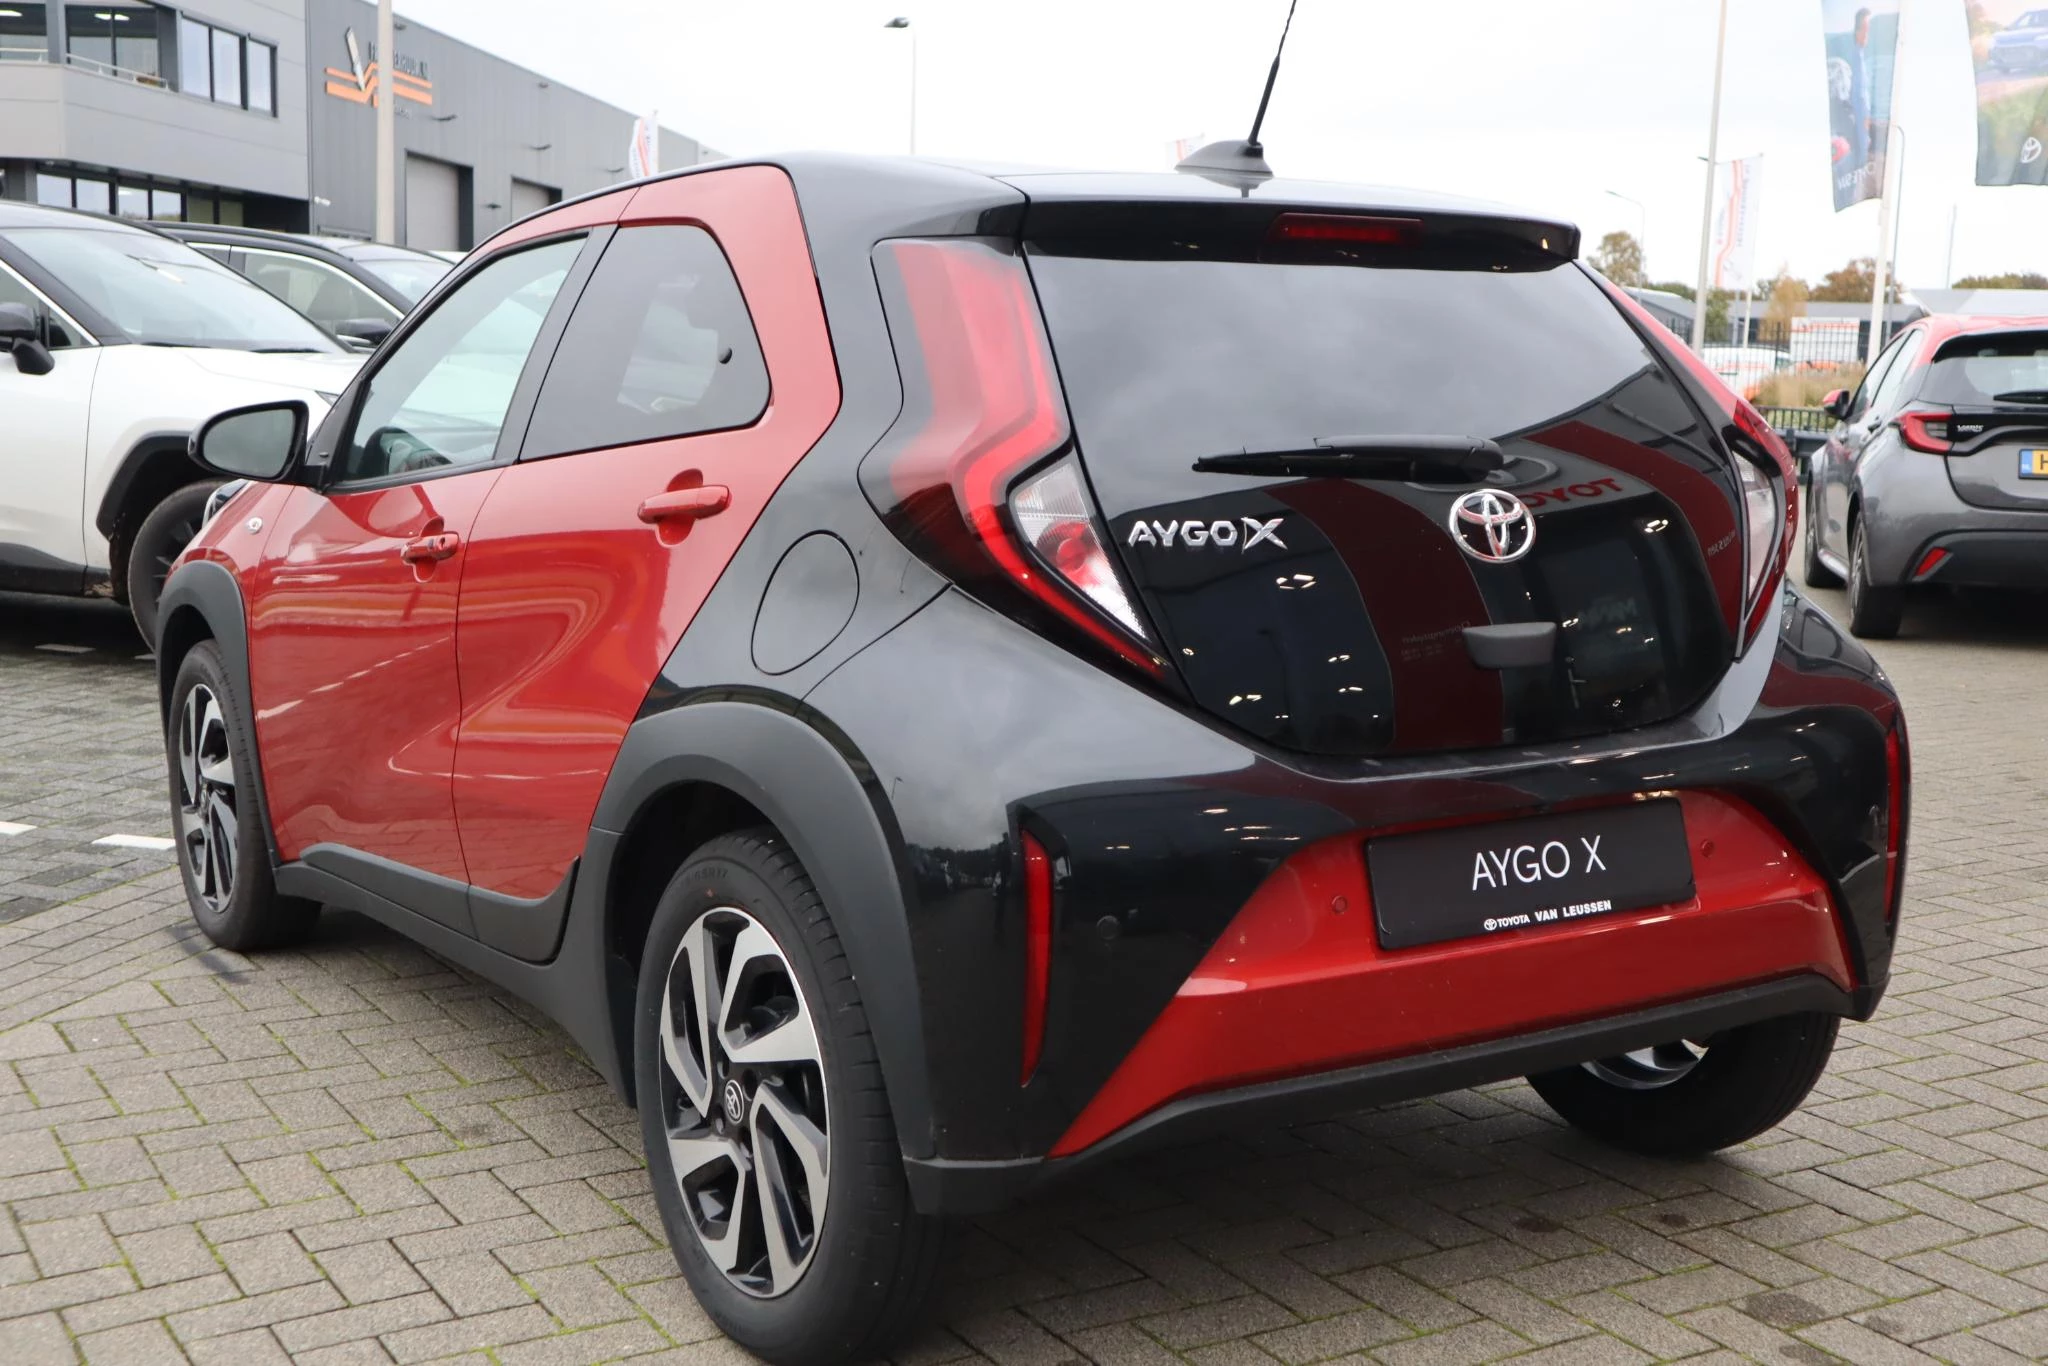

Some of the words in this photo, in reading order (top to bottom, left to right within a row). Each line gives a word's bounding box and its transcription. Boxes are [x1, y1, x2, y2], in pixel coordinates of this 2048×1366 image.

[1472, 841, 1570, 890] AYGO
[1581, 834, 1606, 873] X
[1497, 914, 1531, 928] TOYOTA
[1534, 908, 1558, 922] VAN
[1563, 900, 1612, 917] LEUSSEN
